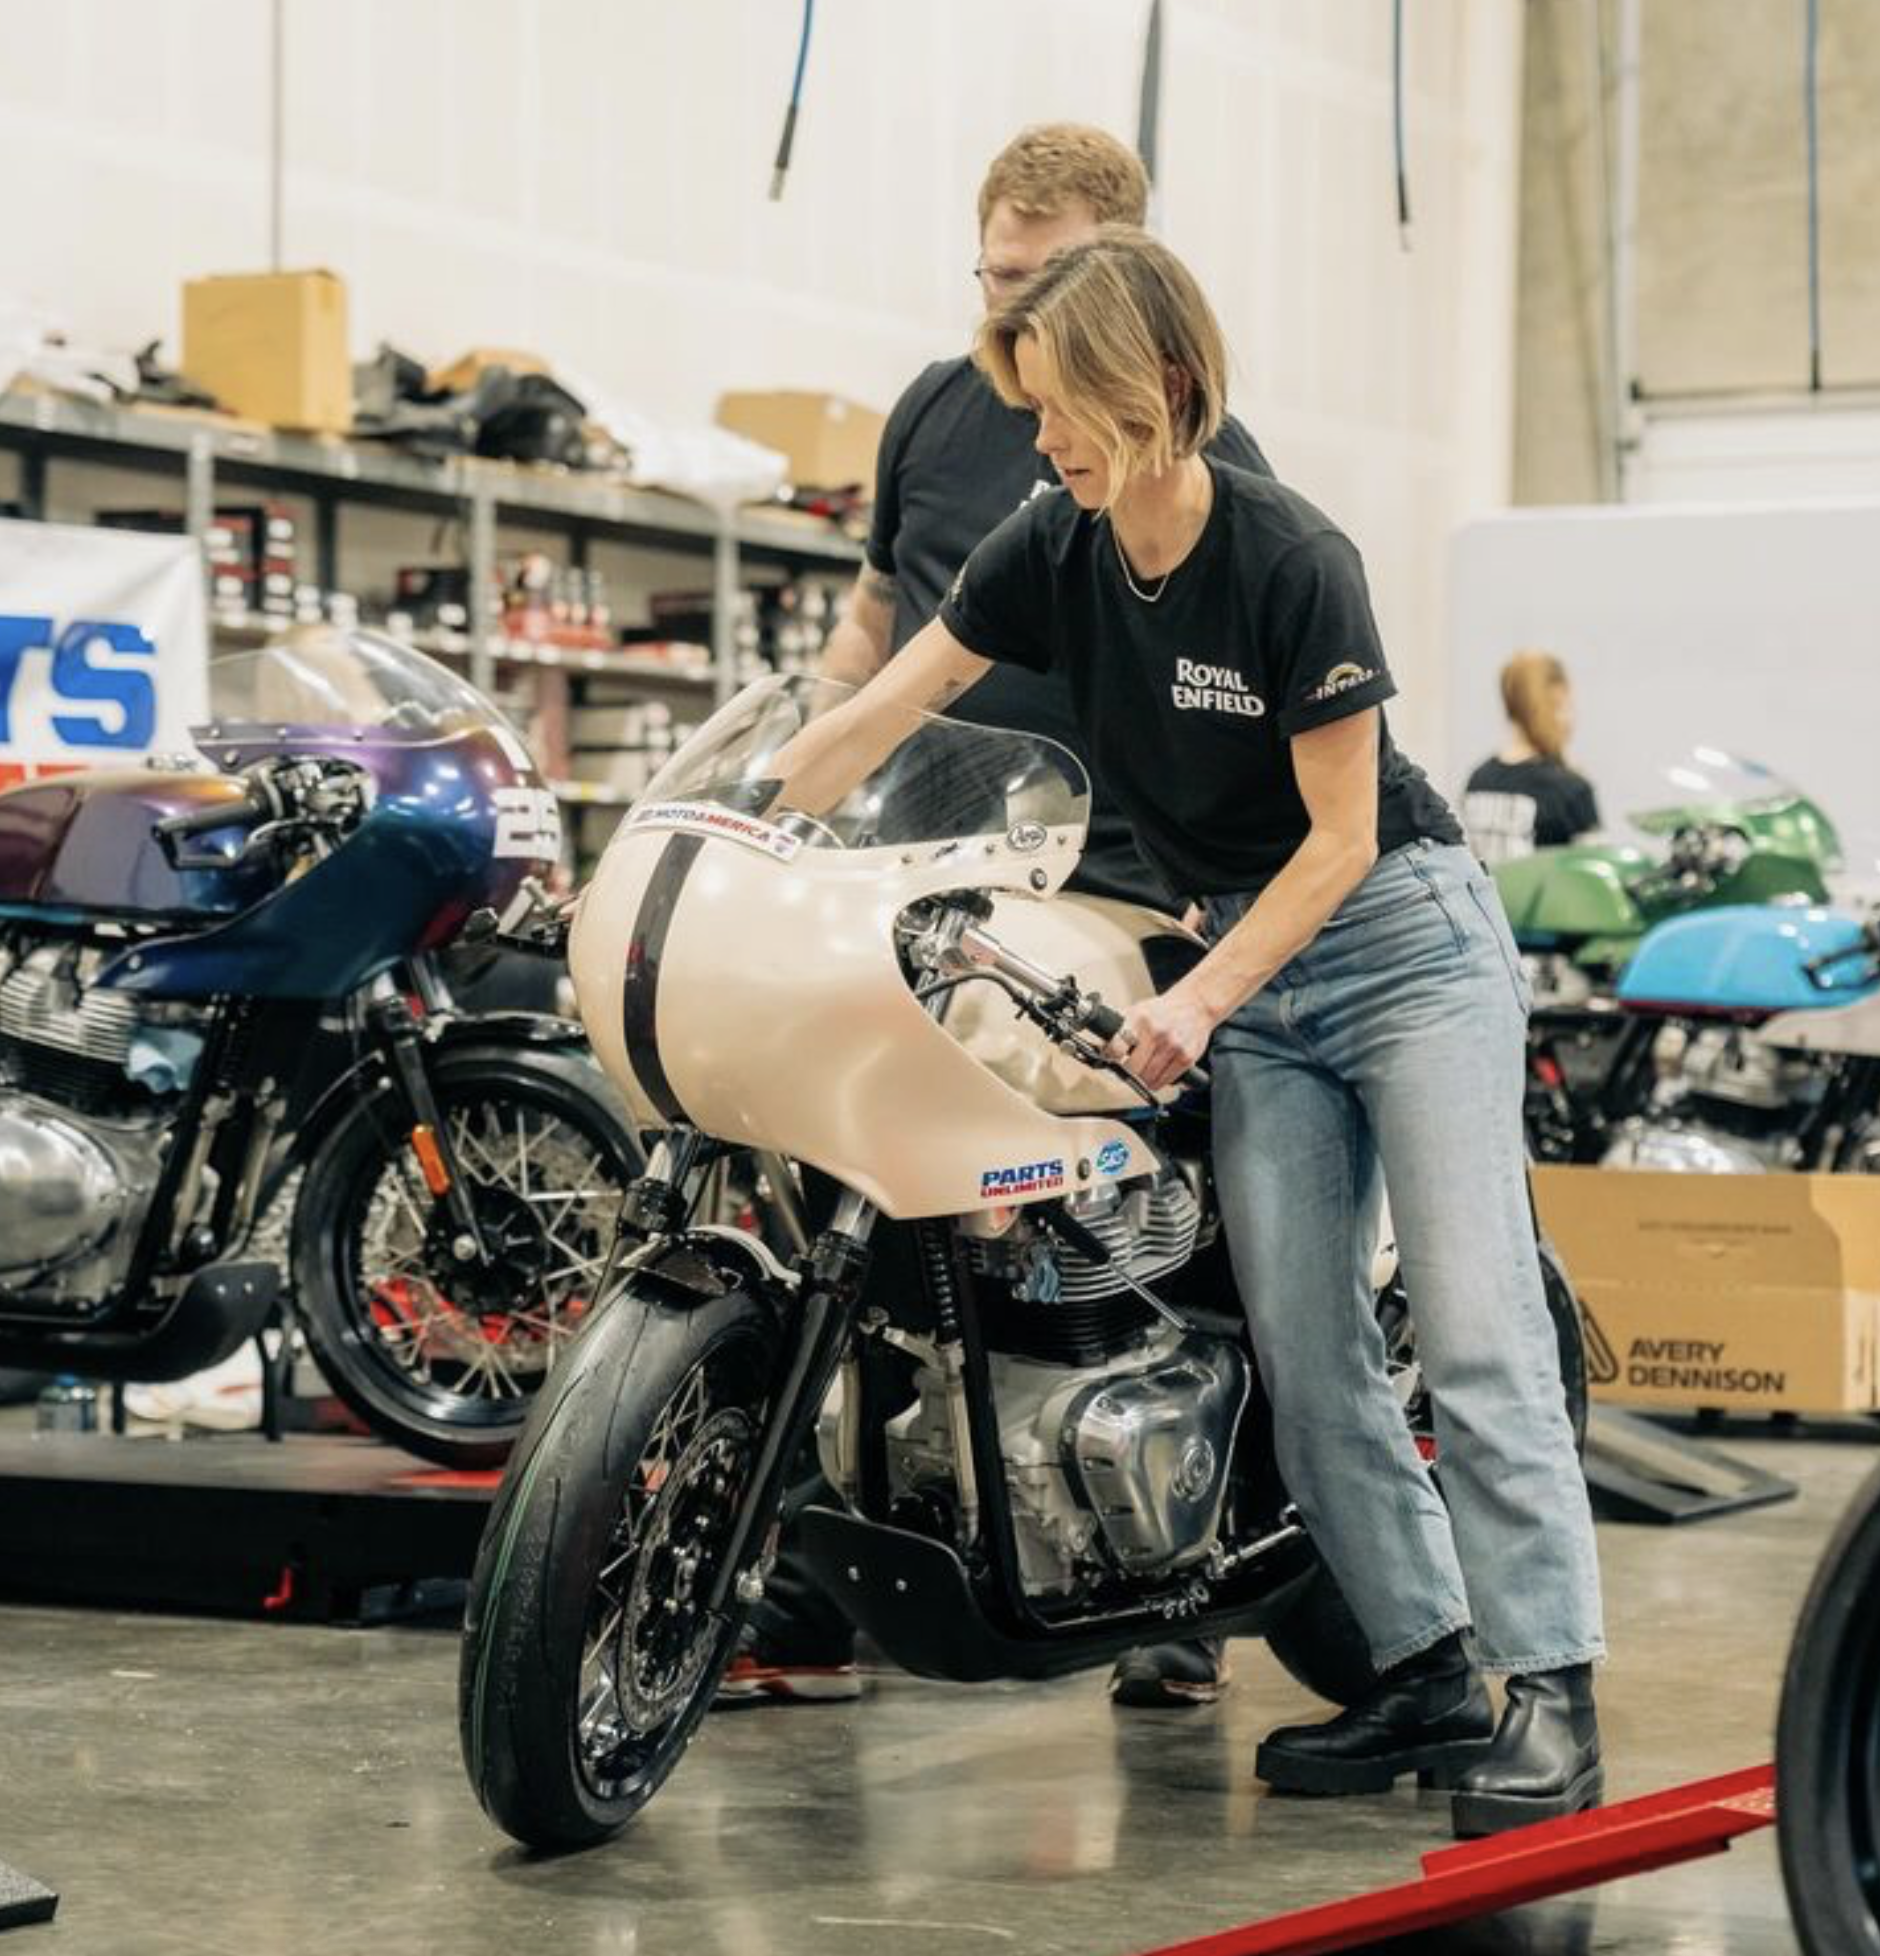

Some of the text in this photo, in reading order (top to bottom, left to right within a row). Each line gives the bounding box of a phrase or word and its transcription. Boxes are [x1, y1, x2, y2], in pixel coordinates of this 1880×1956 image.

[1176, 657, 1249, 692] ROYAL
[1171, 684, 1266, 717] ENFIELD
[982, 1159, 1064, 1186] PARTS
[980, 1176, 1064, 1197] UNLIMITED
[1628, 1338, 1725, 1364] AVERY
[1627, 1365, 1787, 1393] DENNISON
